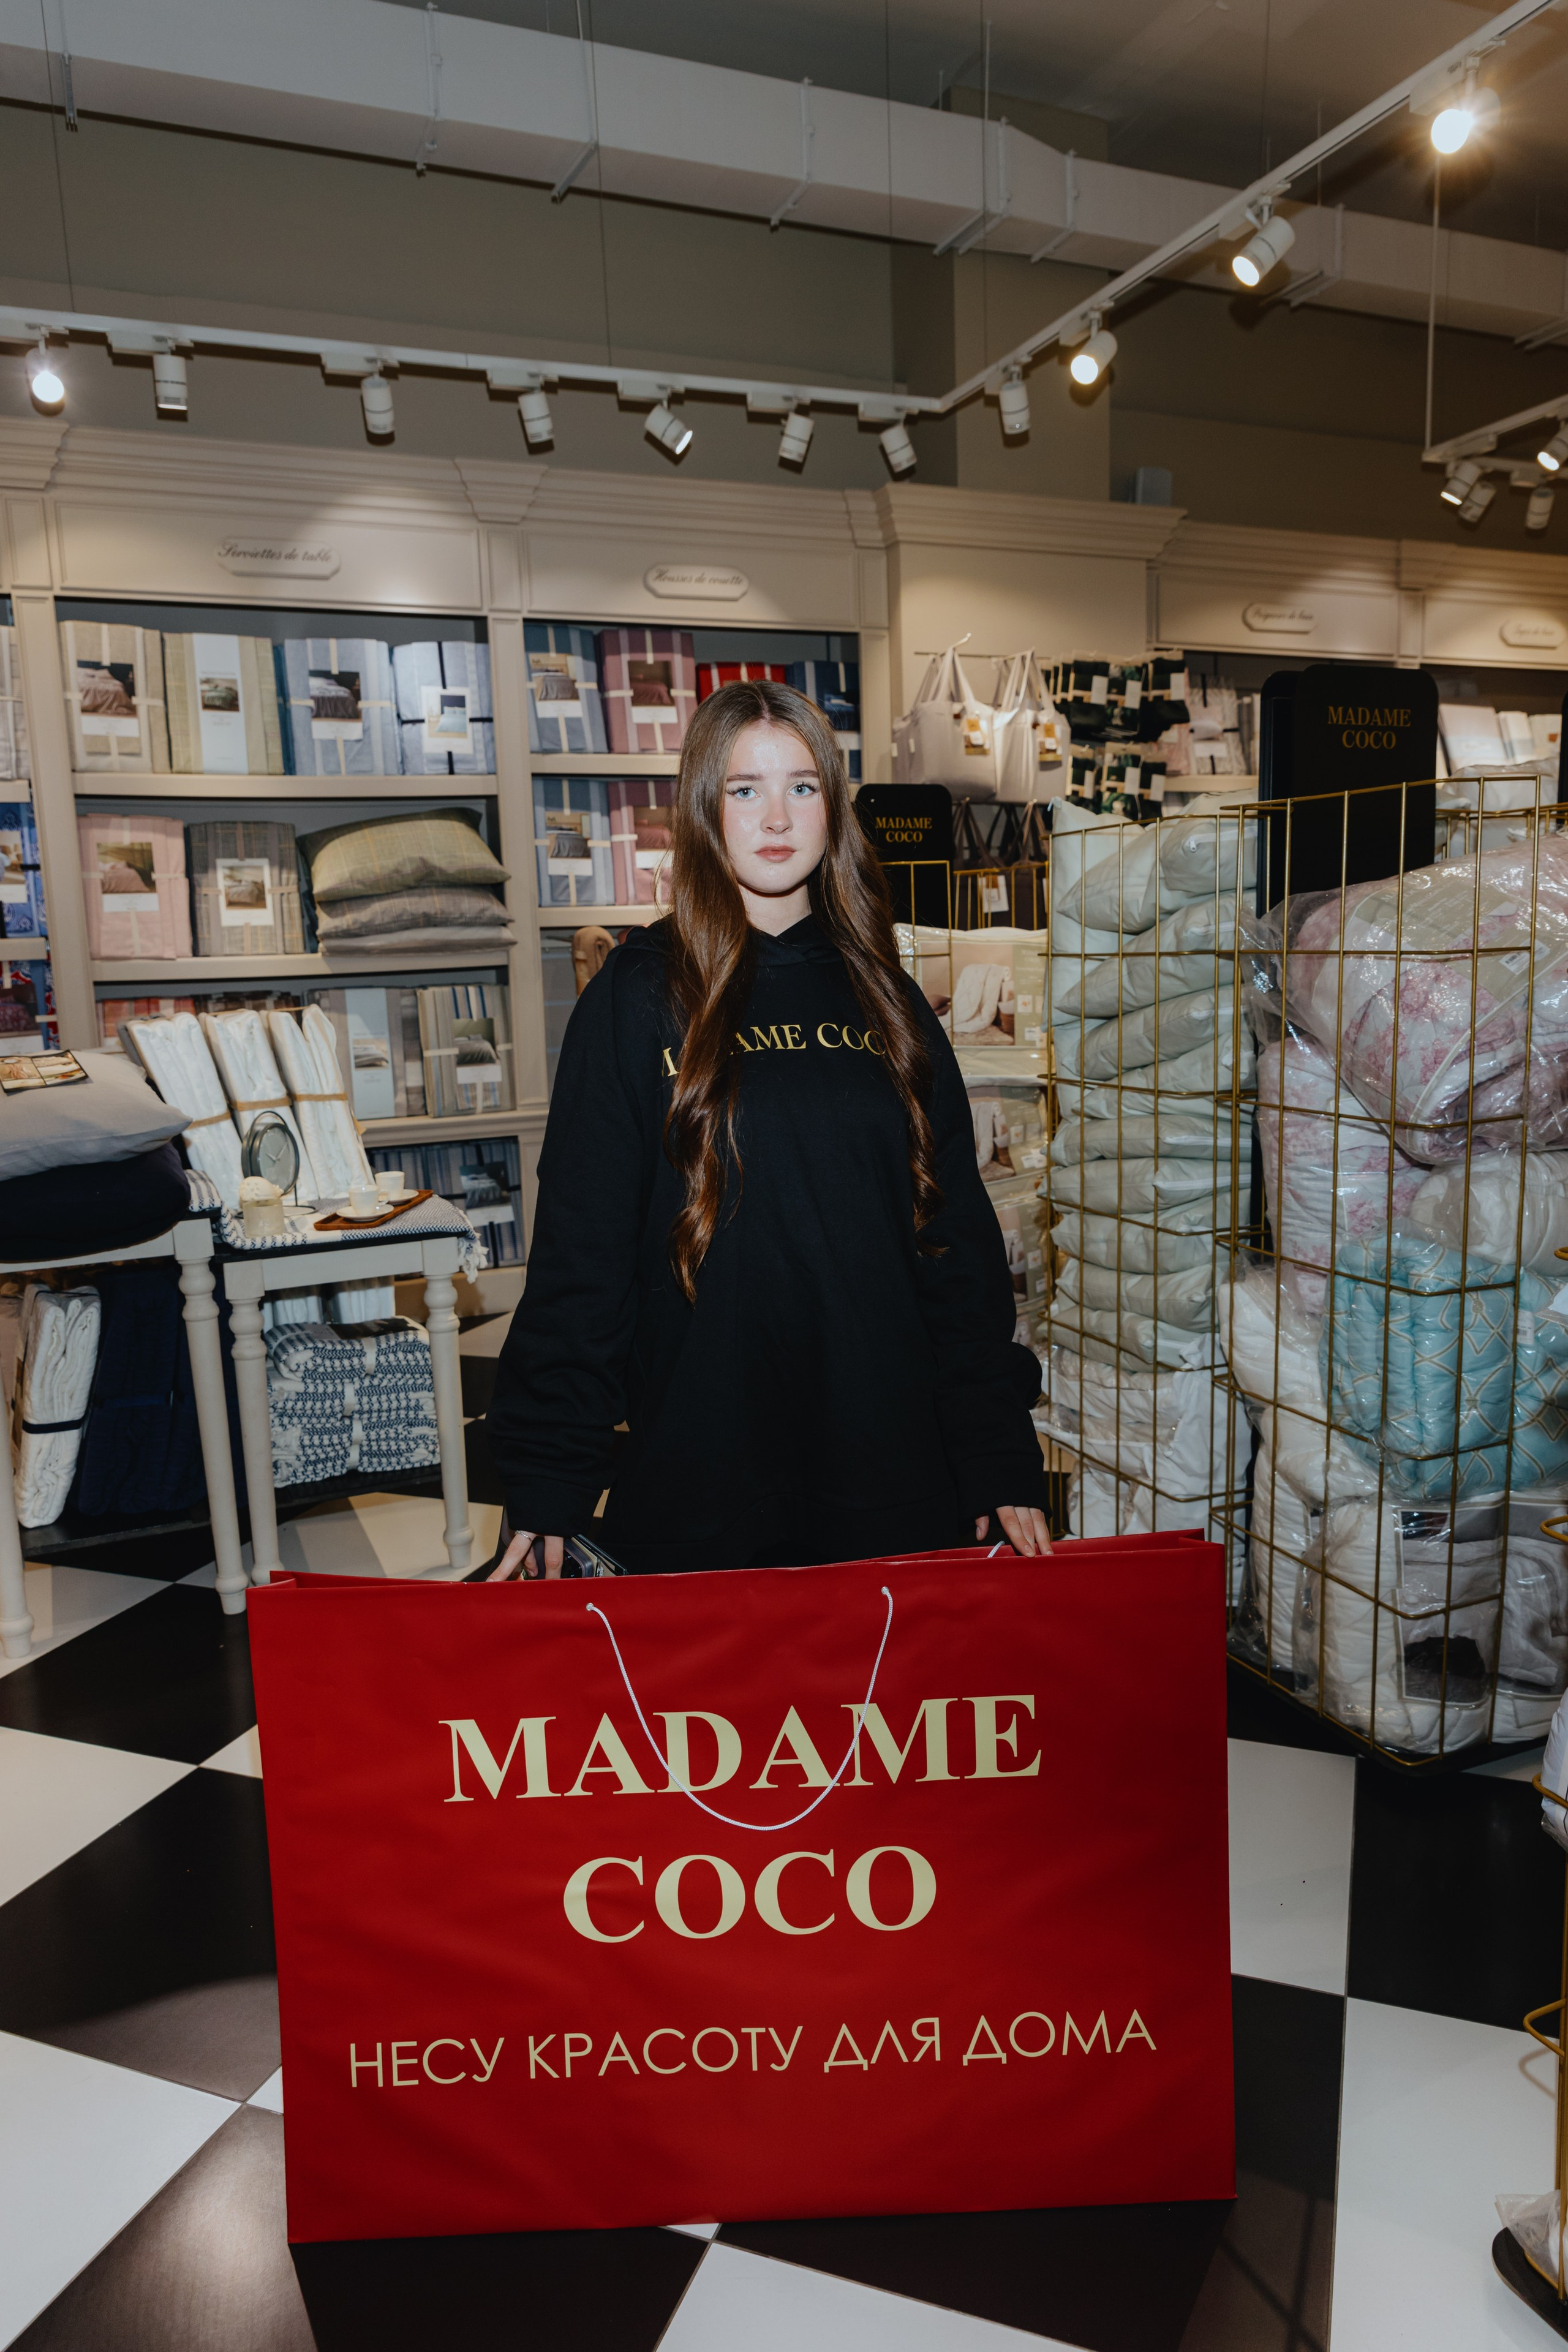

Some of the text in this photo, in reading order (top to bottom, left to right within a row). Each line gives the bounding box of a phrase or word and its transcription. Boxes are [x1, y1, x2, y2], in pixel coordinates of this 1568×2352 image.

[284, 548, 298, 560] de
[1327, 706, 1411, 727] MADAME
[1342, 729, 1396, 749] COCO
[875, 816, 933, 829] MADAME
[886, 830, 923, 843] COCO
[816, 1022, 886, 1056] COC
[439, 1694, 1041, 1803] MADAME
[563, 1845, 937, 1943] COCO
[350, 2009, 1156, 2087] НЕСУ КРАСОТУ ДЛЯ ДОМА
